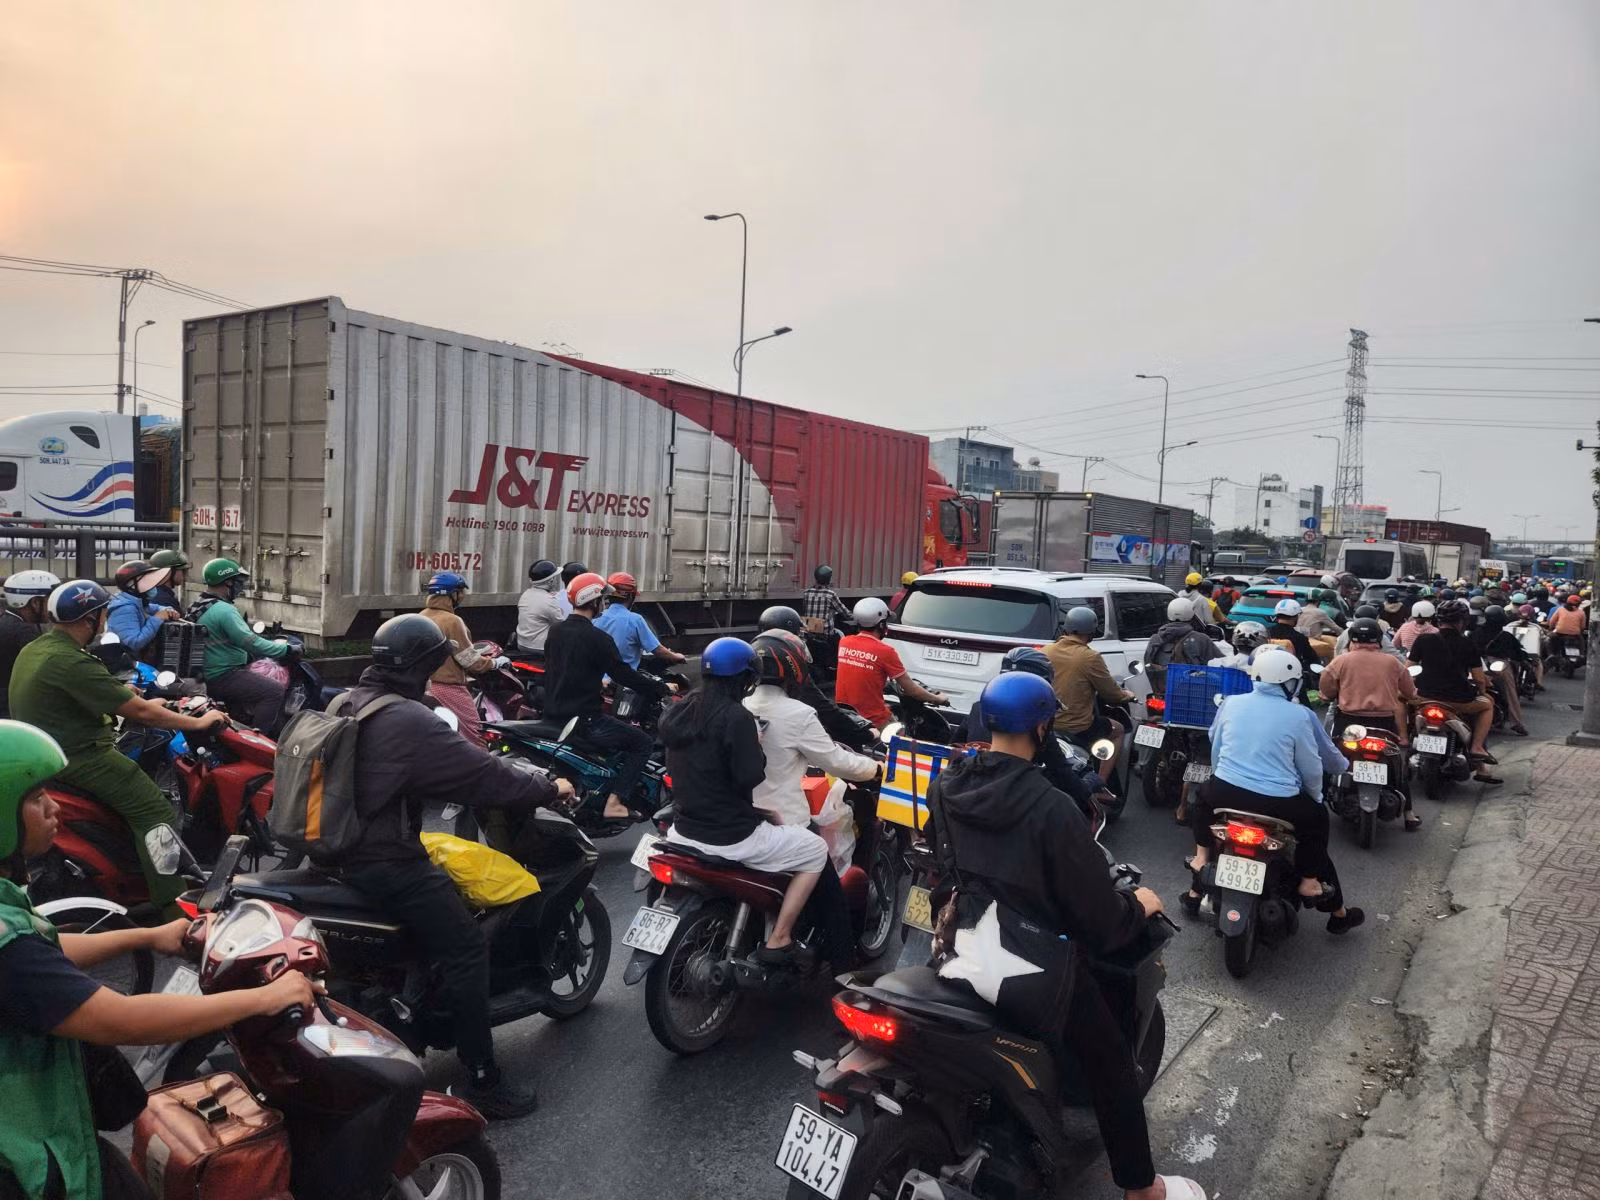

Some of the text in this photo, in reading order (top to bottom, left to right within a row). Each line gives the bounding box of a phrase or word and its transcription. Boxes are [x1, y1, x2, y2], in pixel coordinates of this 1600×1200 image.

[448, 443, 651, 518] J&T EXPRESS
[446, 516, 546, 533] Hotline: 1900 1088
[217, 567, 234, 576] Grab
[845, 648, 878, 662] HOTOSU
[1225, 858, 1259, 877] 59-X3
[1218, 871, 1260, 892] 499.26
[795, 1112, 844, 1163] 59-YA
[783, 1140, 840, 1193] 104.47
